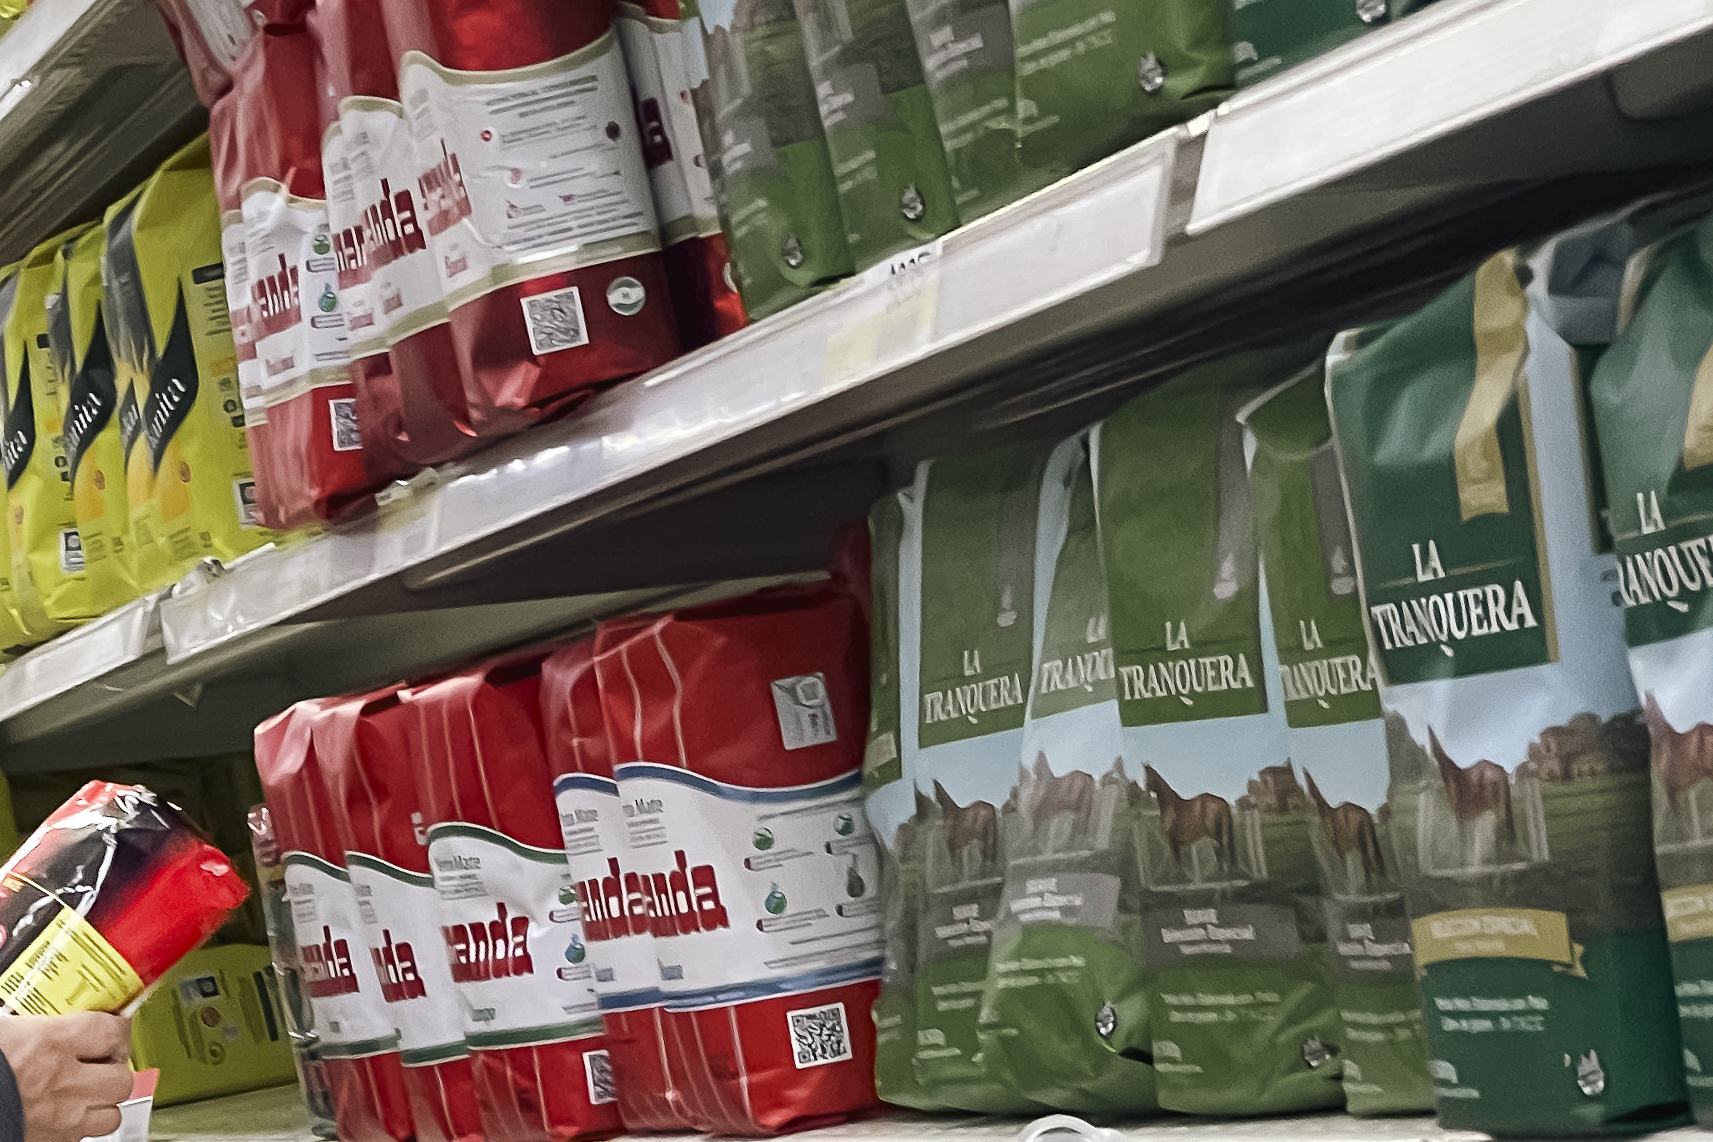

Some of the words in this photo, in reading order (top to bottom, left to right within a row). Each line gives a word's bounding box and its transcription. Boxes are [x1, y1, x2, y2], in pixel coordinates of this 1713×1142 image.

[1636, 489, 1667, 536] LA
[1411, 538, 1446, 583] LA
[1616, 535, 1713, 613] ANQUE
[1164, 619, 1190, 652] LA
[1299, 619, 1324, 651] LA
[1370, 577, 1539, 658] TRANQUERA
[923, 672, 1024, 725] TRANQUERA
[1118, 652, 1255, 706] TRANQUERA
